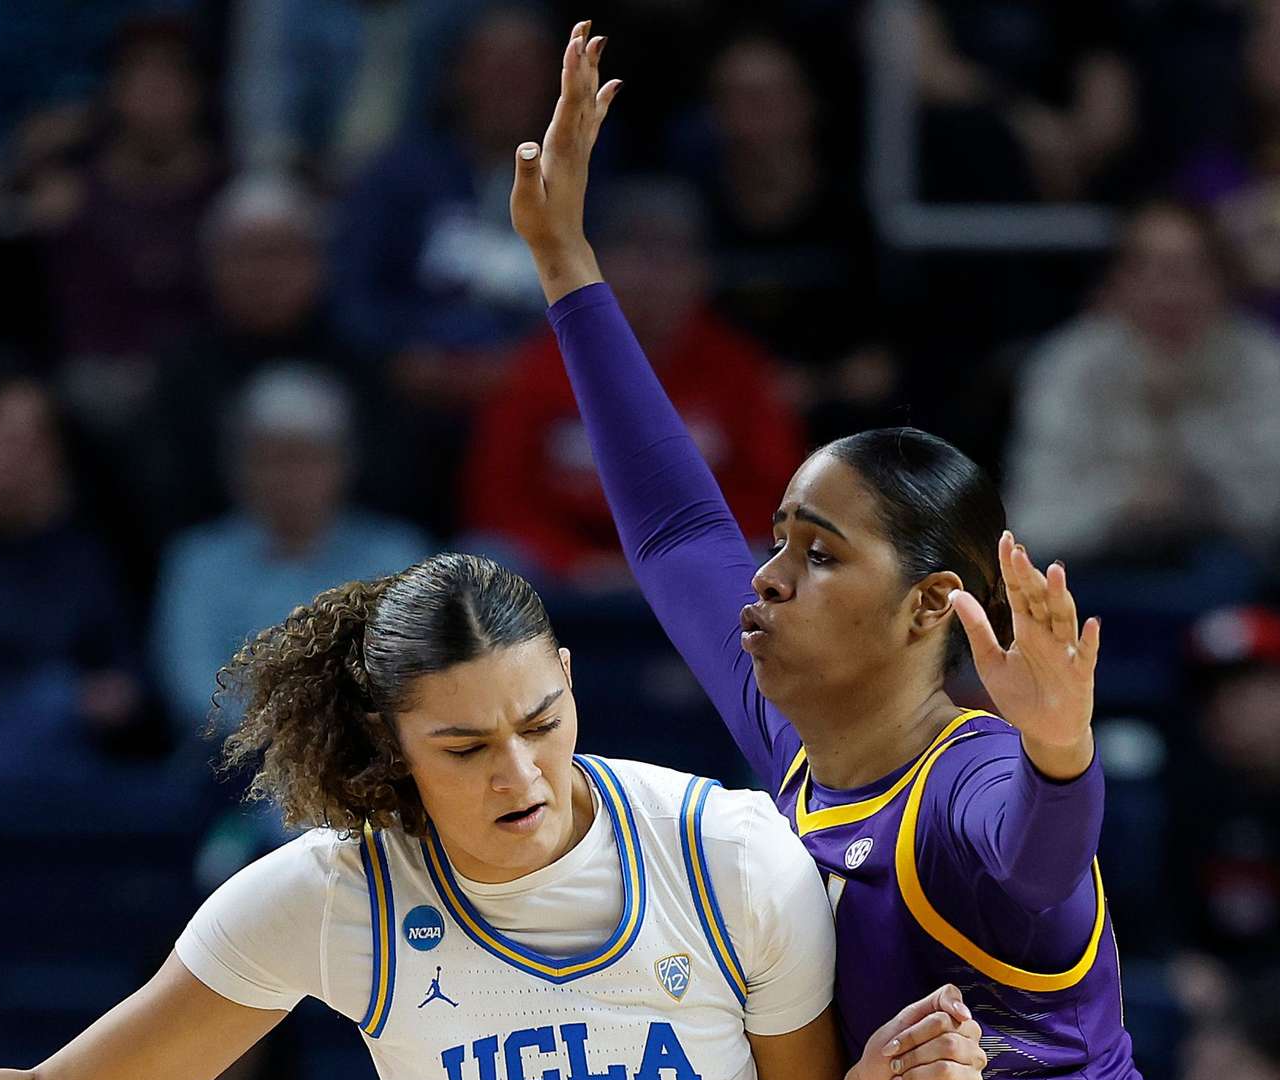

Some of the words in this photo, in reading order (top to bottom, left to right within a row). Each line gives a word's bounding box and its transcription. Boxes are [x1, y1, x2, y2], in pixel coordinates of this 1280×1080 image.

[408, 926, 442, 940] NCAA
[657, 957, 690, 985] PAC
[667, 973, 686, 992] 12
